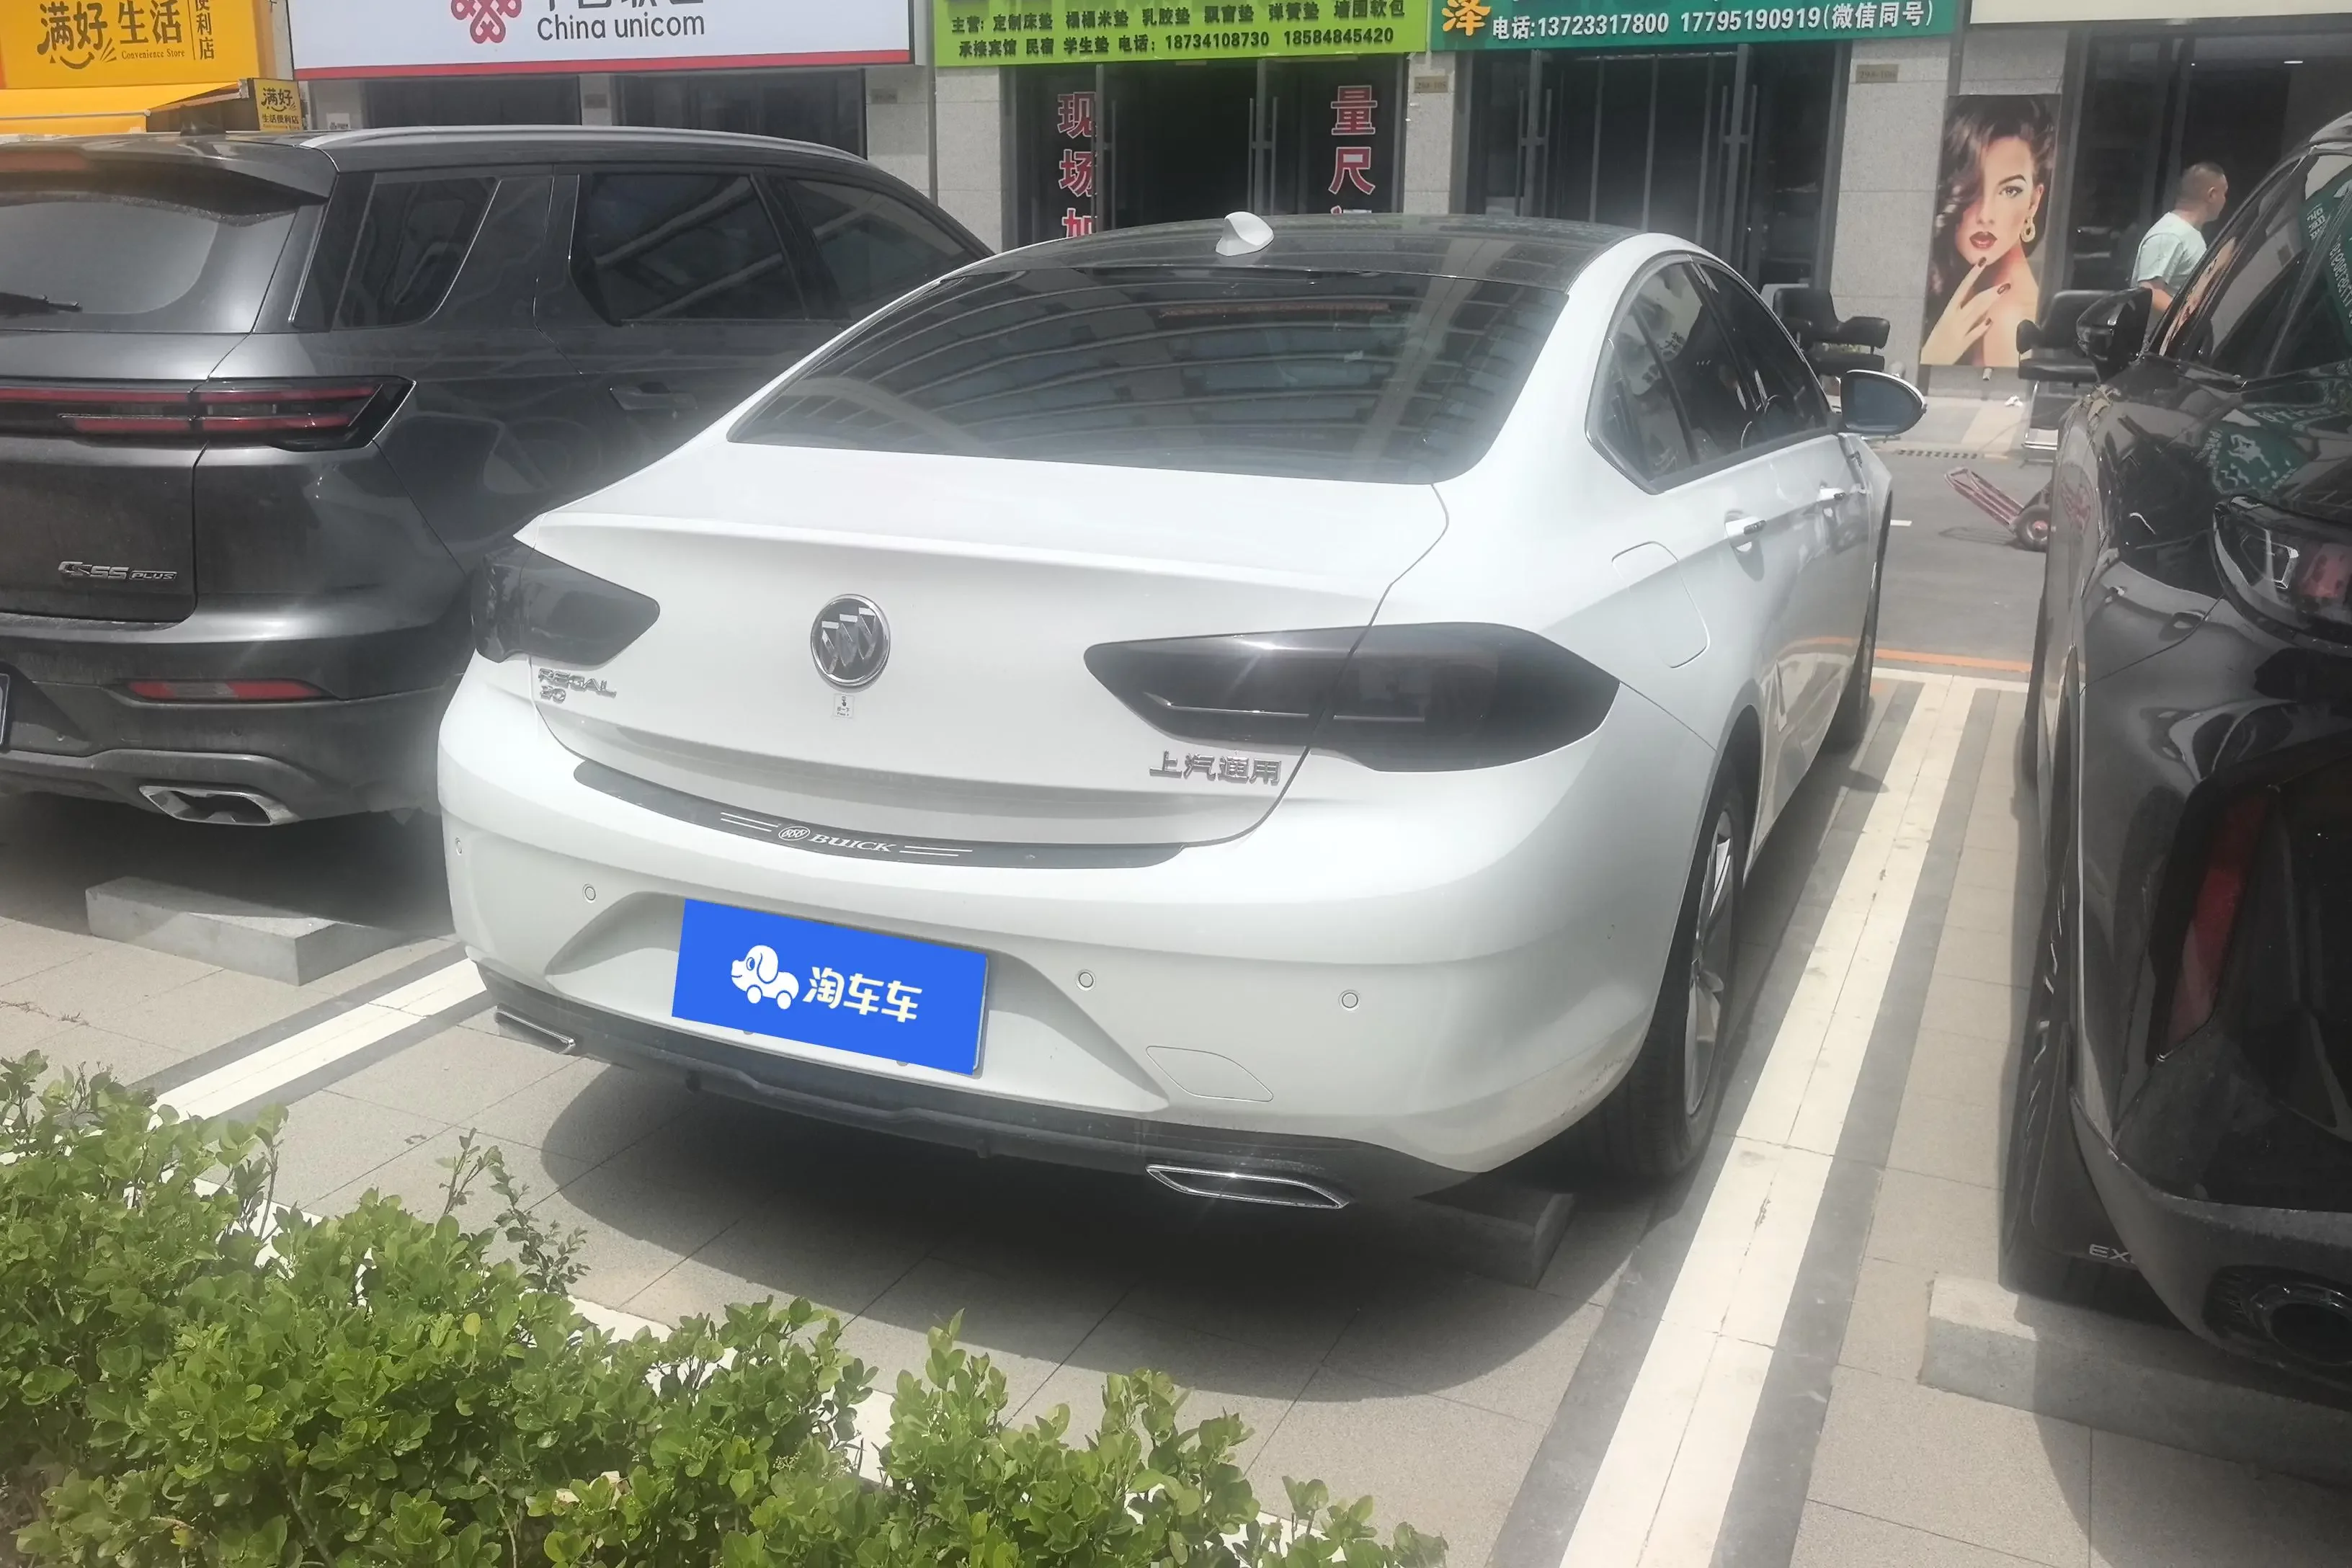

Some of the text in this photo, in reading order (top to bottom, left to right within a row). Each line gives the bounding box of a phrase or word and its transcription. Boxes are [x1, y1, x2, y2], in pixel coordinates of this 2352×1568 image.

[537, 12, 705, 41] China unicom
[1165, 32, 1270, 50] 18734108730
[1284, 27, 1394, 46] 18584845420
[121, 48, 184, 60] Convenience Store
[261, 87, 293, 107] 满好
[1329, 85, 1377, 213] 量尺
[538, 668, 617, 699] REGAL
[1149, 749, 1281, 786] 上汽通用
[808, 834, 897, 852] BUICK
[2090, 1244, 2135, 1264] EX
